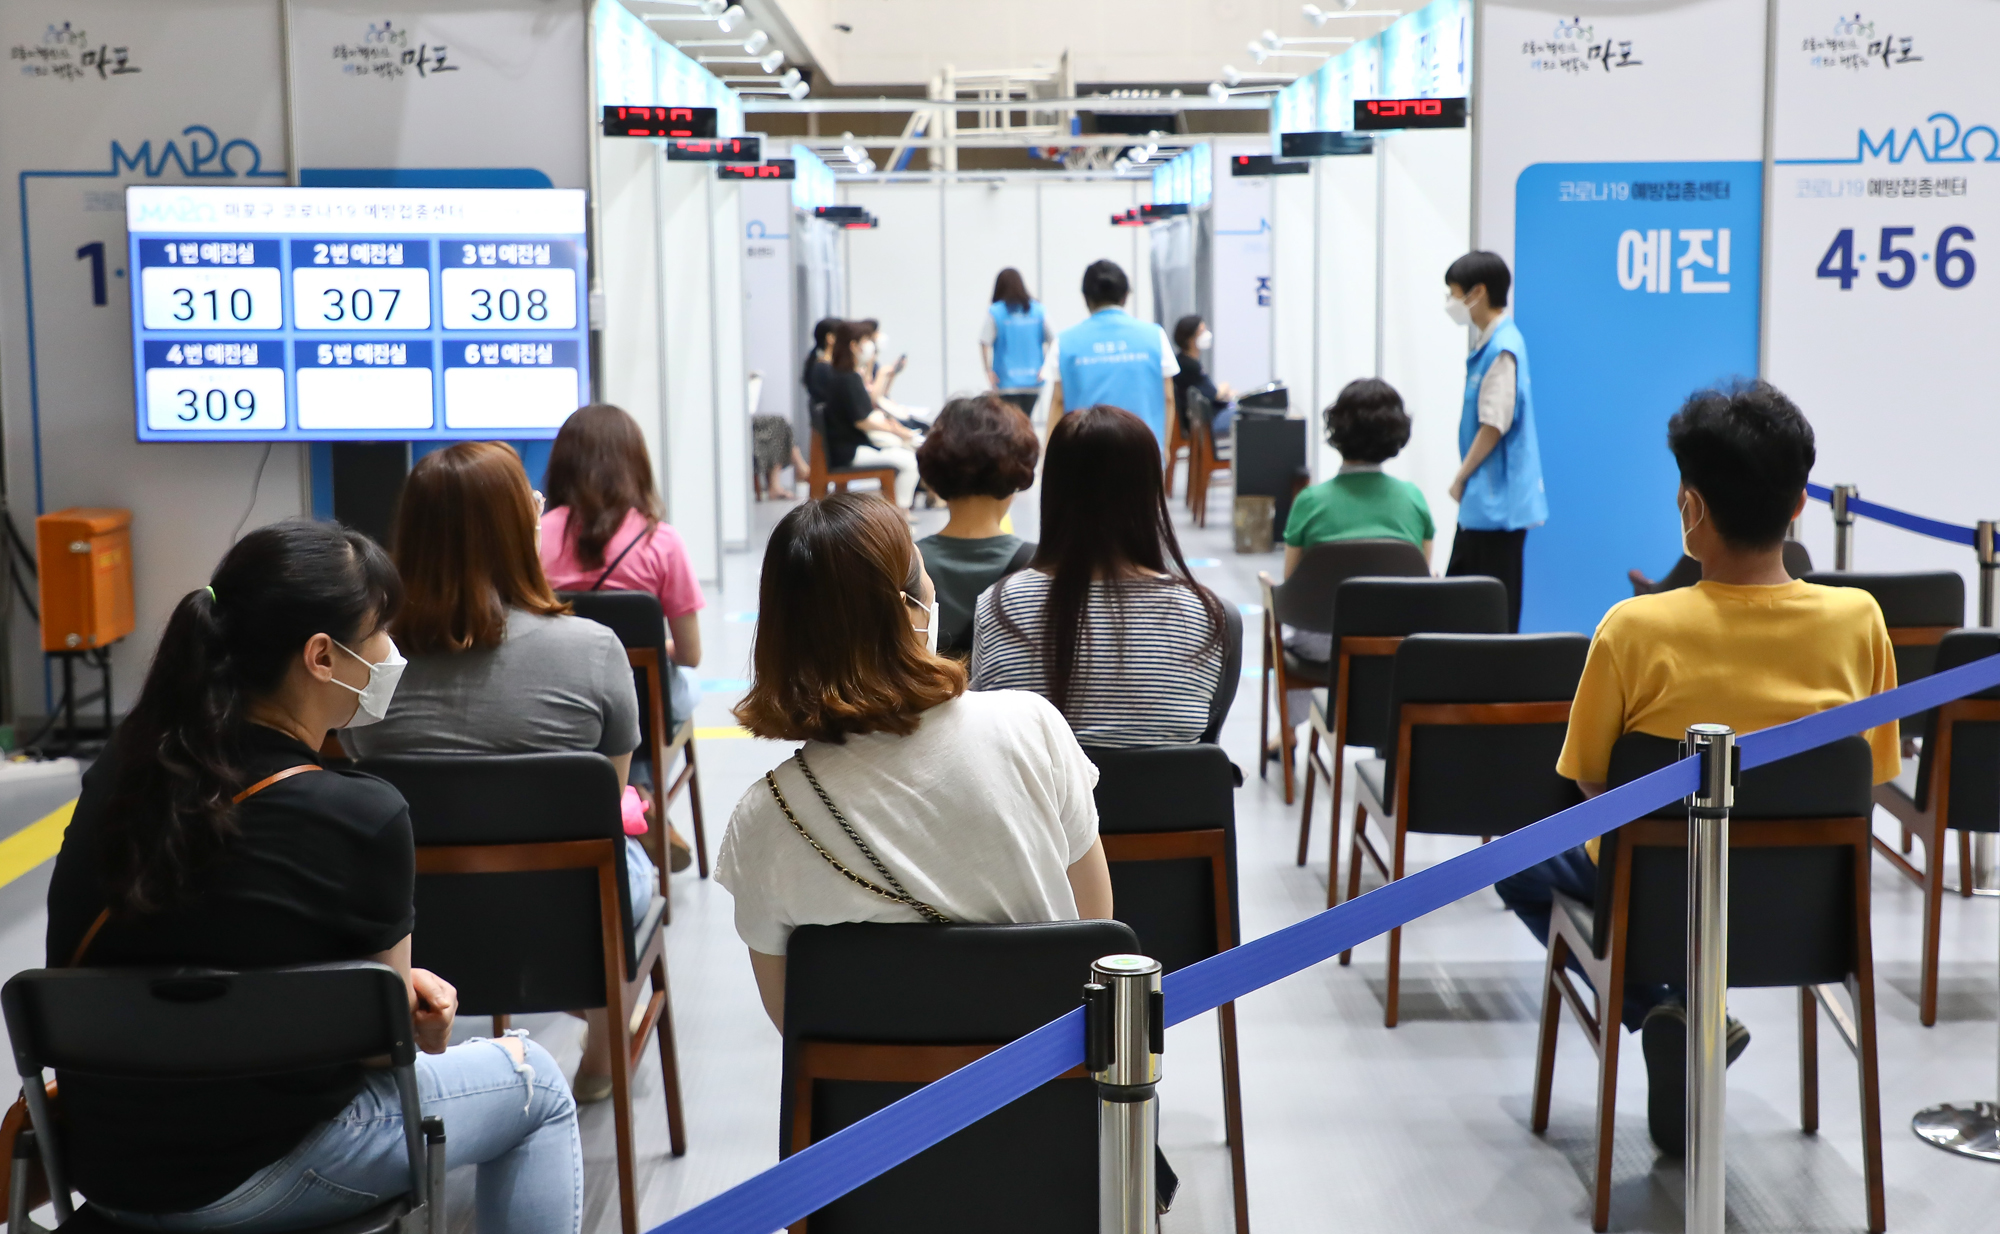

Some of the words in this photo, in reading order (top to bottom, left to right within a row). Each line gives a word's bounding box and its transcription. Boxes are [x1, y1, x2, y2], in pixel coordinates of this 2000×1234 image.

[81, 44, 142, 80] 마포
[401, 43, 459, 78] 마포
[1588, 38, 1643, 73] 마포
[1867, 34, 1924, 69] 마포
[1559, 181, 1629, 202] 코로나19
[1631, 180, 1731, 202] 예방접종센터
[1796, 177, 1865, 199] 코로나19
[1866, 176, 1967, 199] 예방접종센터
[225, 203, 274, 219] 마포구
[284, 203, 356, 219] 코로나19
[364, 204, 464, 220] 예방접종센터
[1617, 228, 1731, 294] 예진
[173, 288, 252, 321] 310
[323, 288, 401, 321] 307
[471, 288, 548, 321] 308
[177, 389, 255, 421] 309
